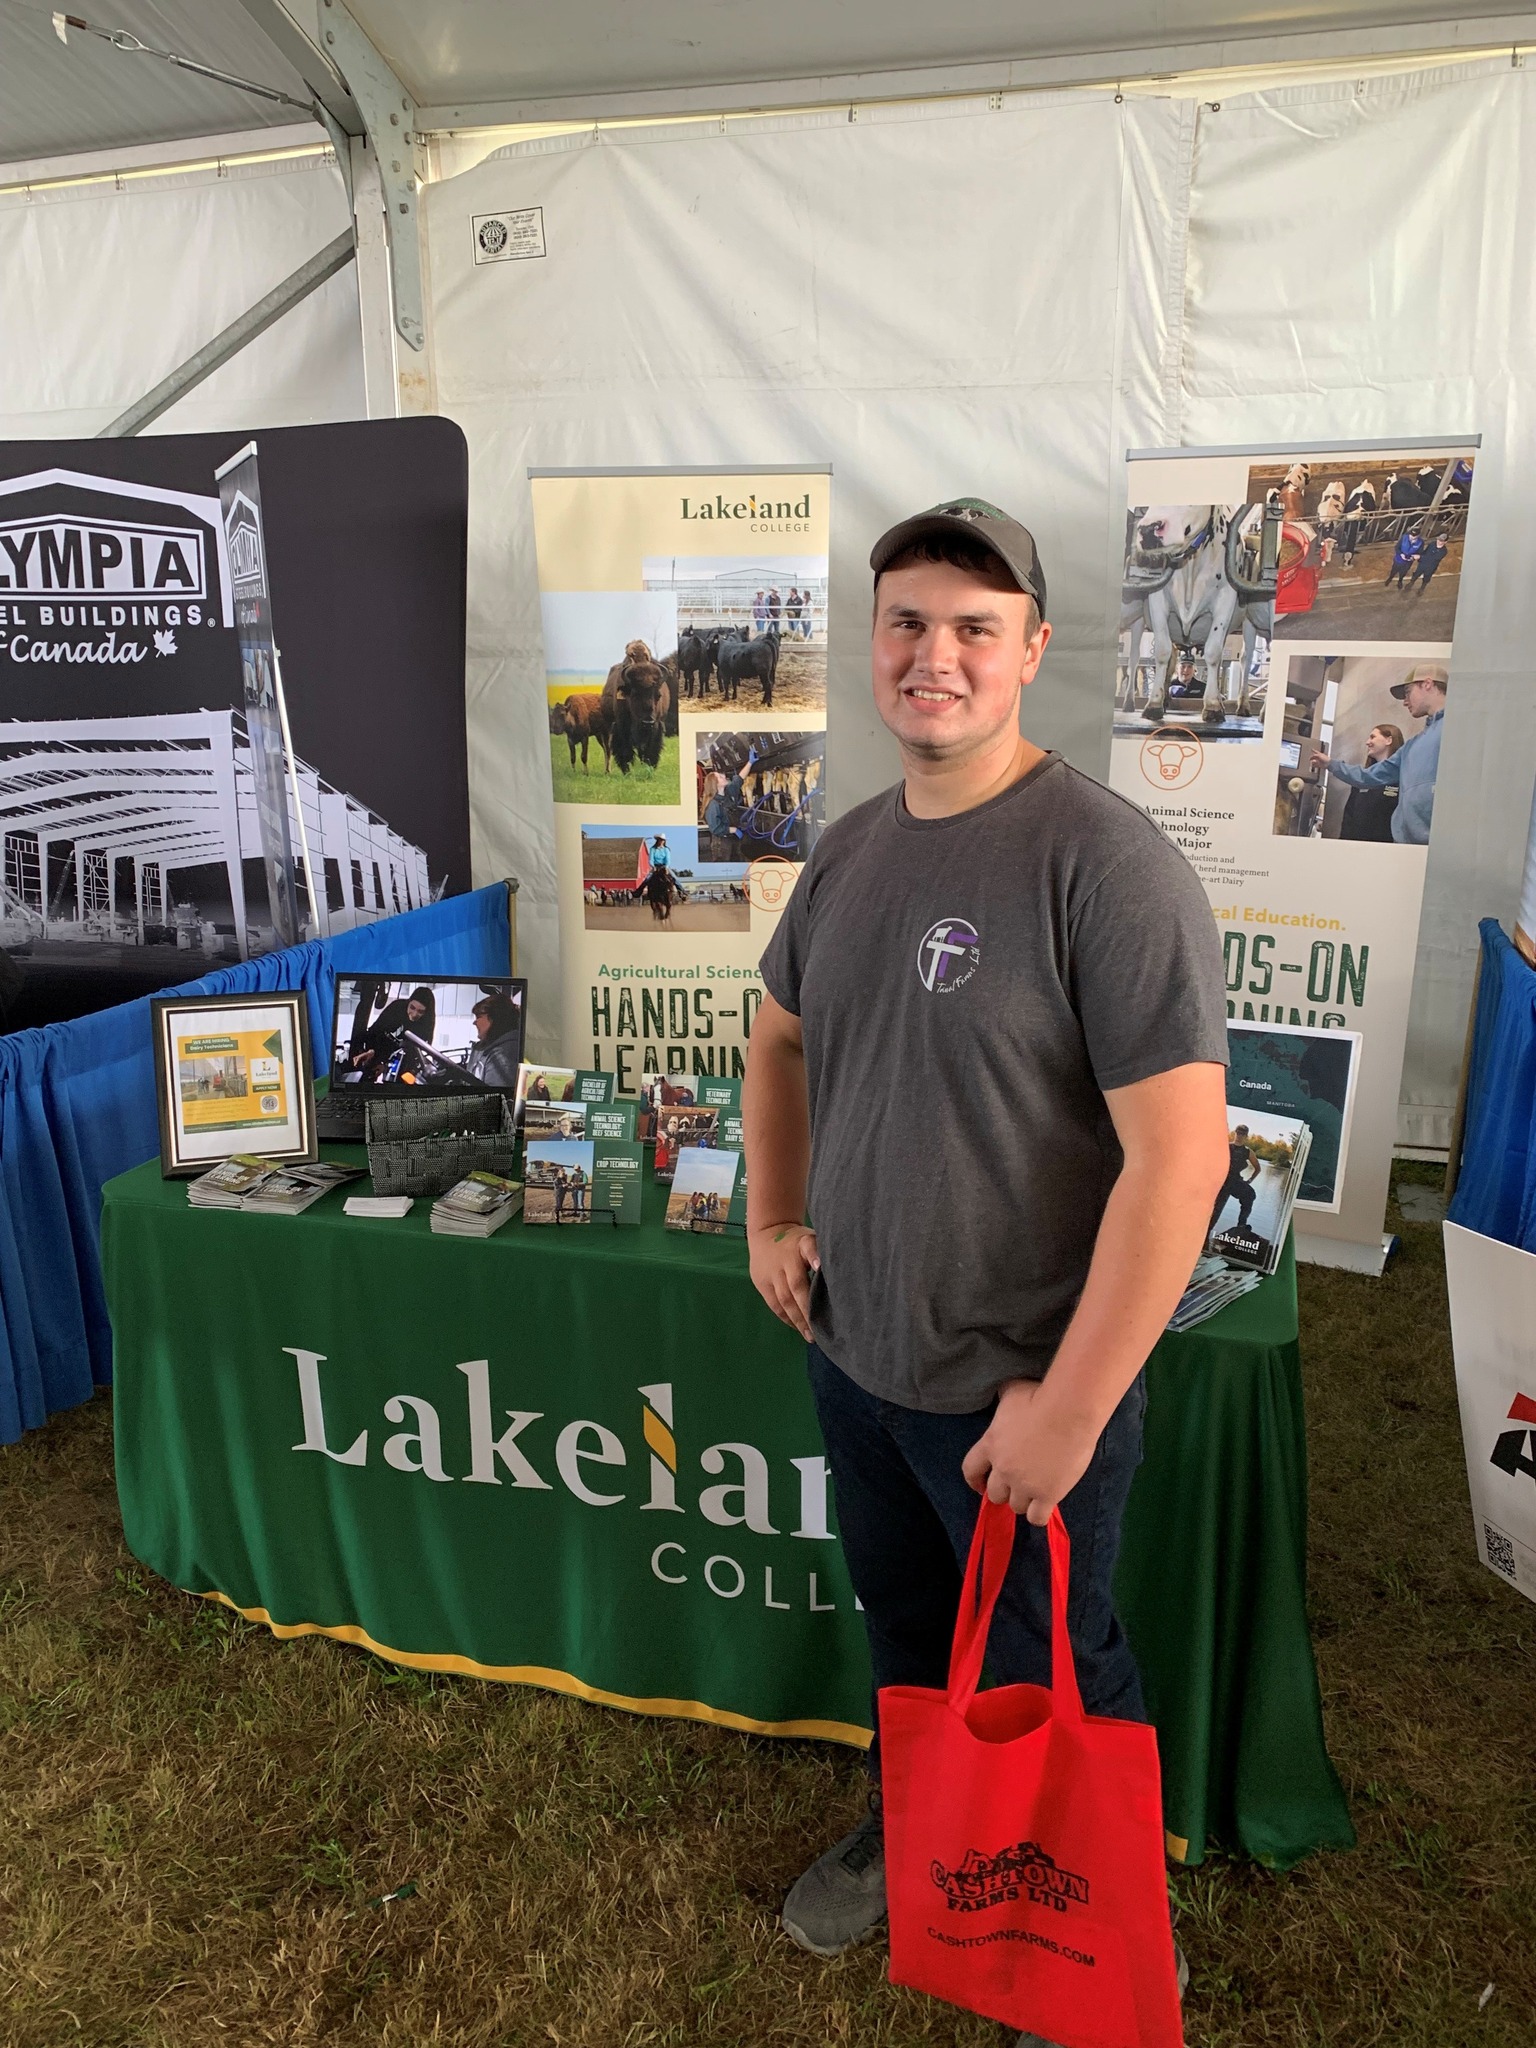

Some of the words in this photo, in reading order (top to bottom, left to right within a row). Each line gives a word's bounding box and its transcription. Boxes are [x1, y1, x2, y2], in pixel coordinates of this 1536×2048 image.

[680, 494, 811, 520] Lakeland
[750, 523, 810, 533] COLLEGE
[0, 528, 195, 589] YMPIA
[10, 631, 148, 664] Canada
[1190, 807, 1235, 820] Science
[1159, 821, 1210, 836] hnology
[1176, 836, 1213, 850] Major
[1220, 856, 1235, 864] and
[1199, 864, 1217, 873] herd
[1218, 867, 1270, 877] management
[1199, 875, 1221, 884] e-art
[1222, 876, 1244, 887] Dairy
[1243, 907, 1346, 931] Education.
[598, 964, 700, 981] Agricultural
[1239, 1079, 1272, 1090] Canada
[1212, 1230, 1260, 1251] Lakeland
[651, 1541, 865, 1611] COLL
[947, 1886, 1019, 1912] FARMS
[1027, 1886, 1068, 1913] LTD
[927, 1926, 1096, 1967] CASHTOWNFARMS.COM
